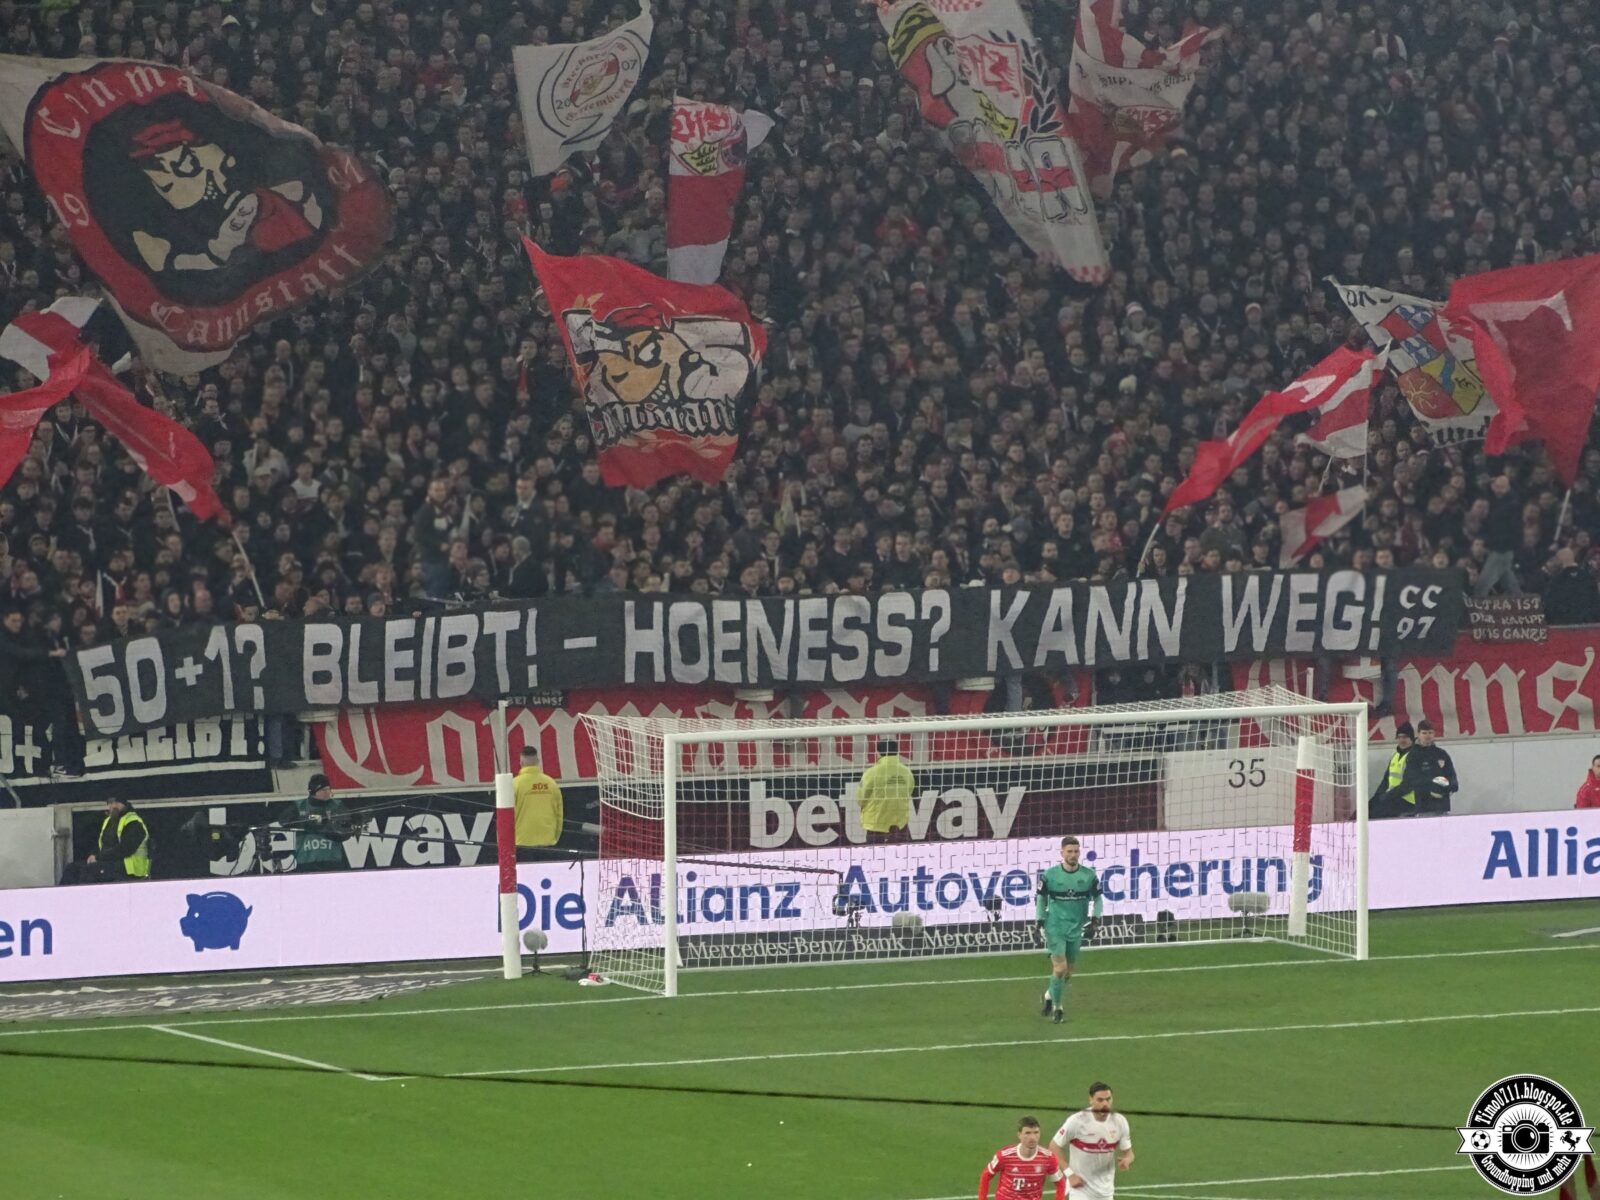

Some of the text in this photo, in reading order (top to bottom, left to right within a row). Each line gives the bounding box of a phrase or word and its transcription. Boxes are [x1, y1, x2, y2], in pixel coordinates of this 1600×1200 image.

[47, 193, 91, 228] 19
[150, 243, 363, 345] Cannstatt
[1400, 584, 1443, 609] CC
[1396, 616, 1436, 639] 97
[77, 623, 267, 735] 50+1?
[303, 608, 538, 705] BLEIBT!
[624, 590, 951, 684] HOENESS?
[986, 577, 1188, 672] KANN
[1221, 570, 1387, 653] WEG!
[1228, 758, 1266, 788] 35
[498, 878, 586, 933] Die
[1090, 919, 1137, 940] ank
[687, 934, 905, 960] Mercedes-Benz Bank
